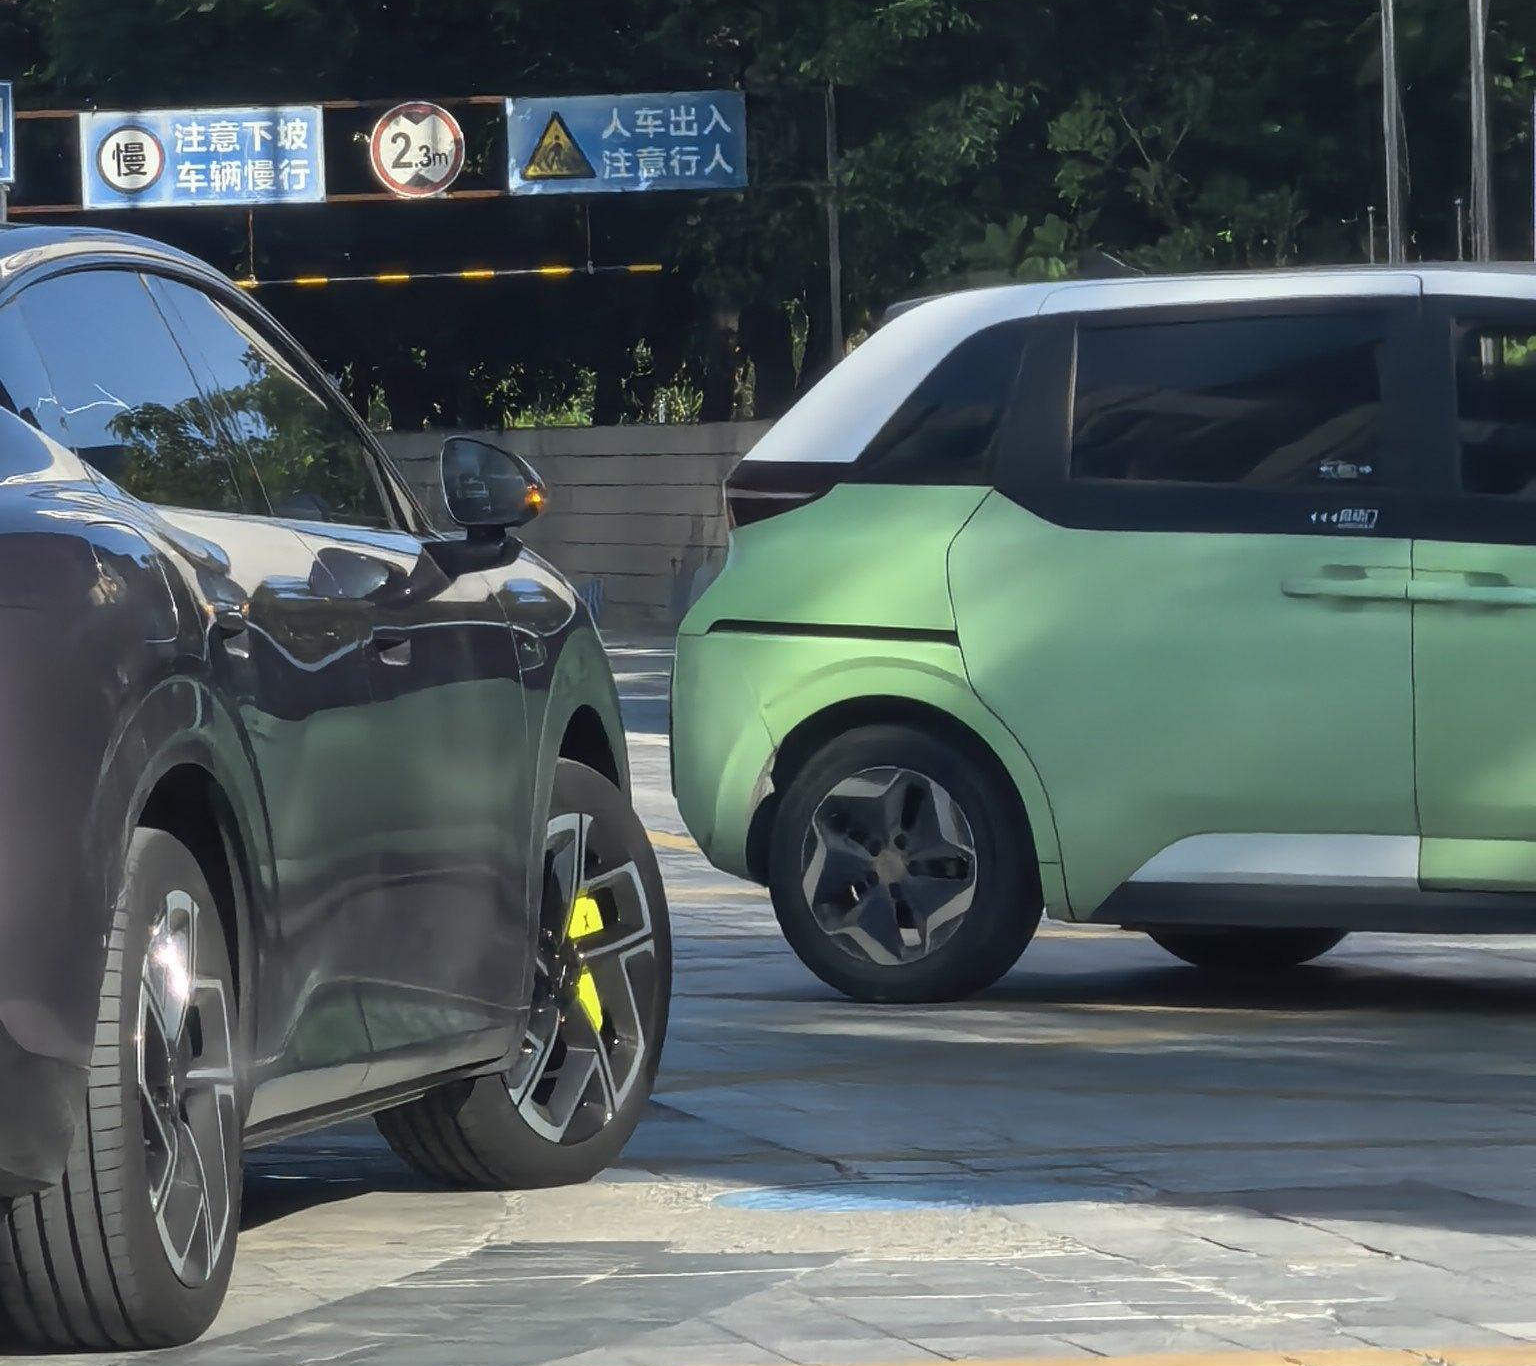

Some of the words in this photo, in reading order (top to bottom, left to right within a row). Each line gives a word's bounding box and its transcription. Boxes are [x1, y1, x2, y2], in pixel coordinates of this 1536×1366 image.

[174, 117, 309, 154] 注意下坡
[601, 104, 733, 140] 人车出入
[111, 141, 148, 178] 慢
[389, 131, 449, 170] 2.3m
[601, 142, 735, 180] 注意行人
[174, 158, 311, 194] 车辆慢行
